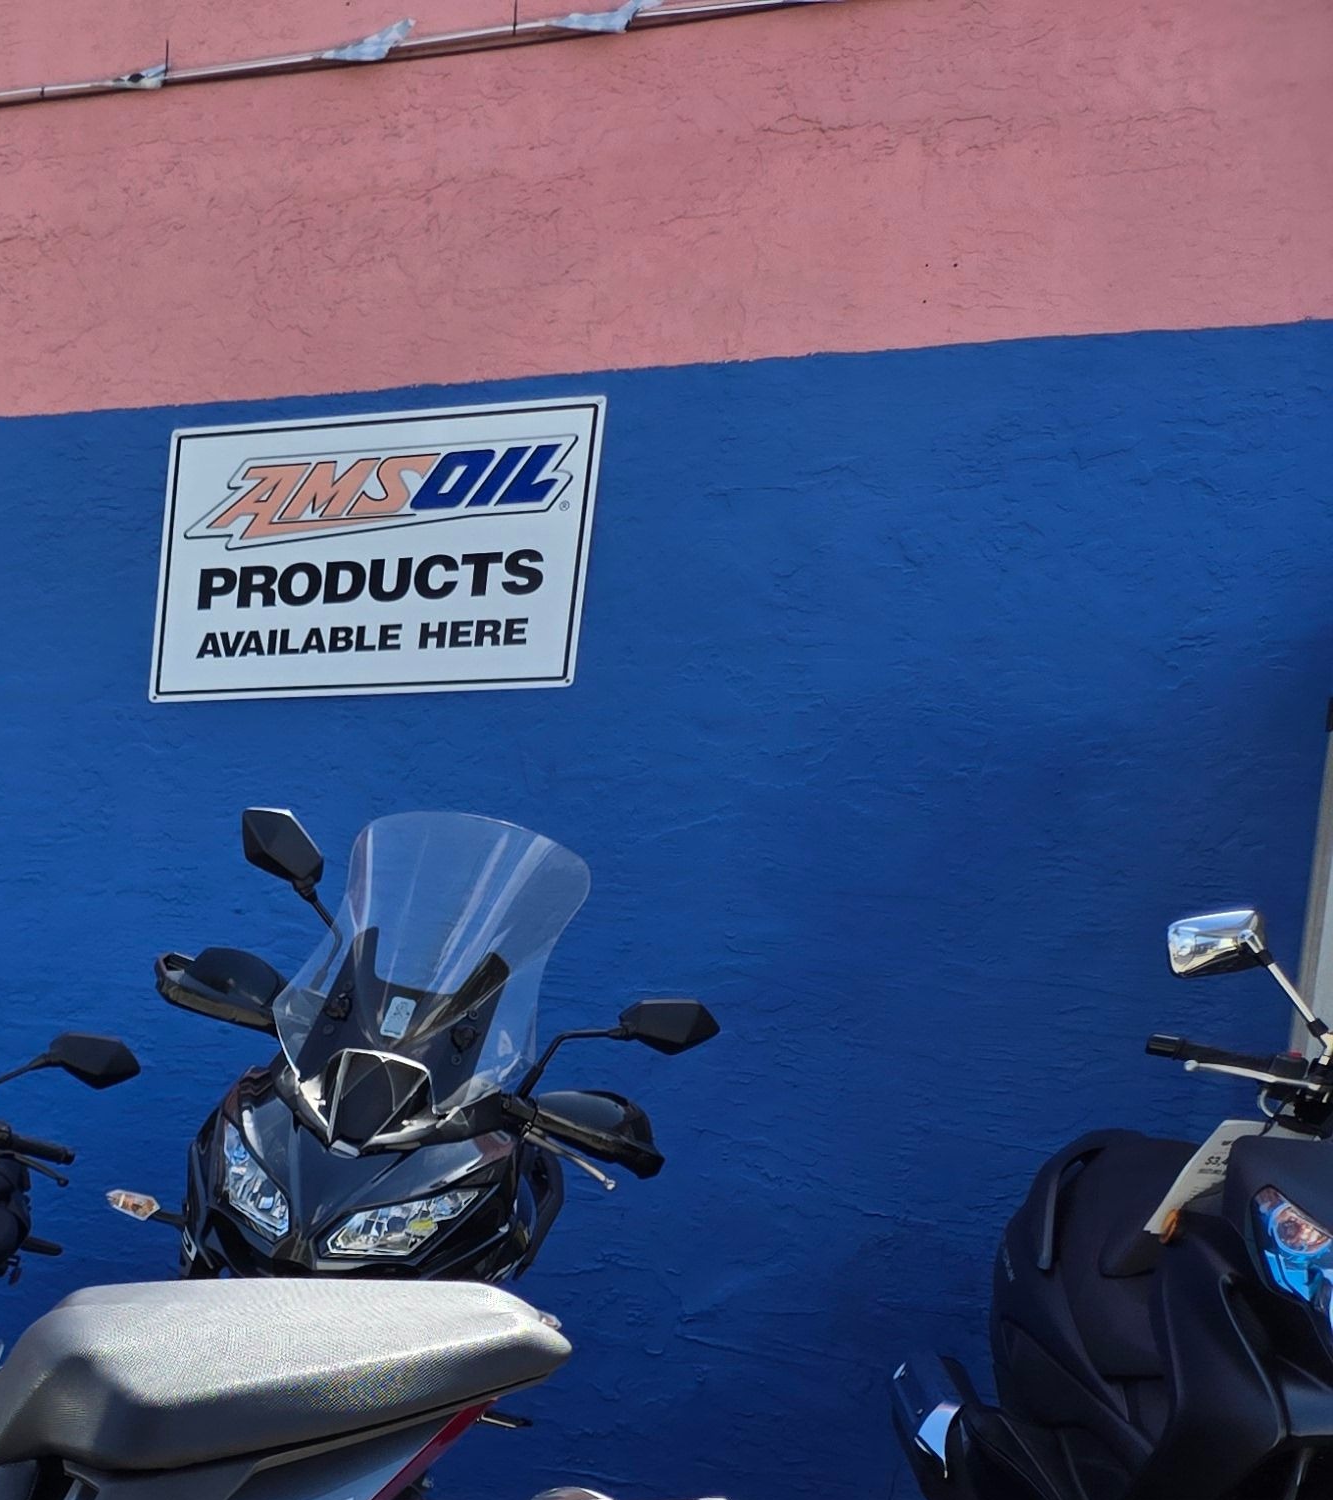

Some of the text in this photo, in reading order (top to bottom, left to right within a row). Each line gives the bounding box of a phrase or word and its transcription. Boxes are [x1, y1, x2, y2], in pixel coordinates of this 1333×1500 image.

[206, 442, 563, 540] AMSOIL
[197, 548, 544, 611] PRODUCTS
[195, 617, 529, 660] AVAILABLE HERE
